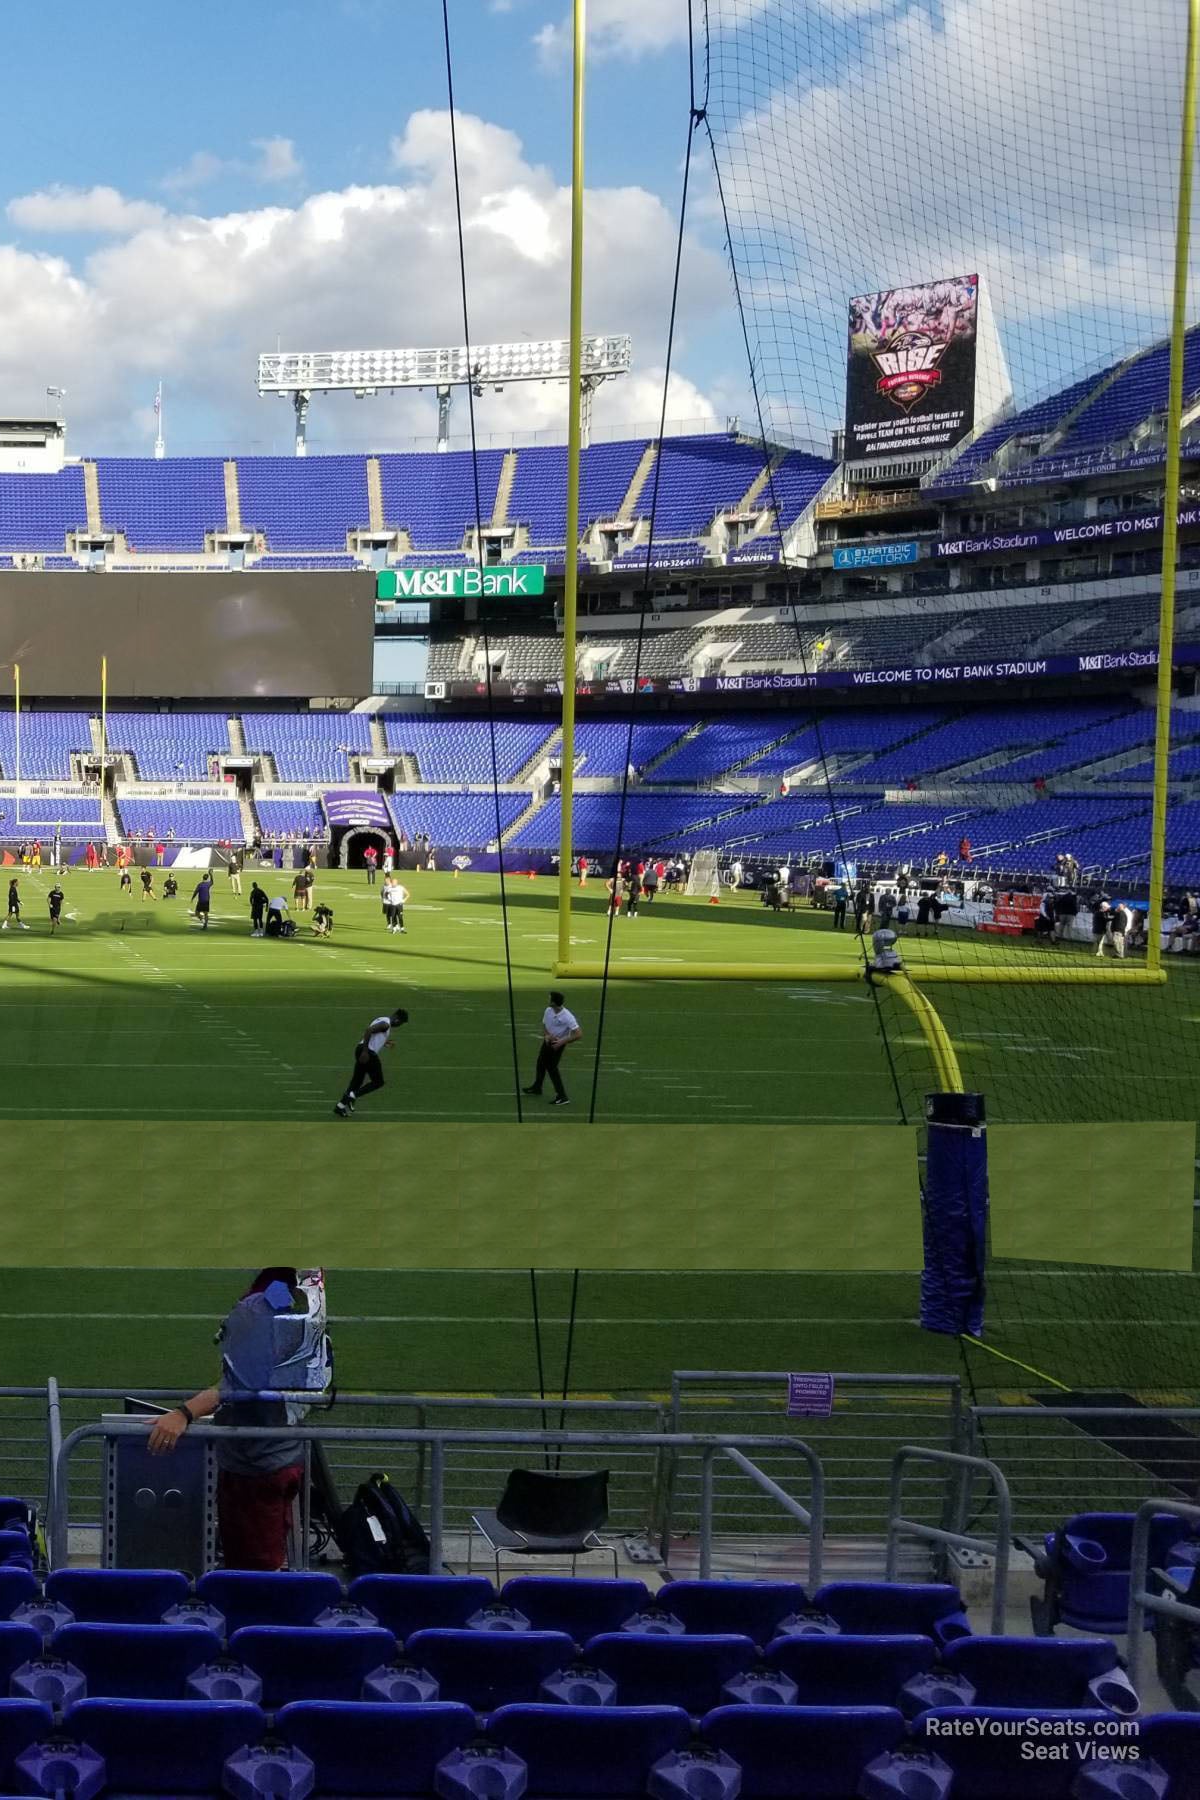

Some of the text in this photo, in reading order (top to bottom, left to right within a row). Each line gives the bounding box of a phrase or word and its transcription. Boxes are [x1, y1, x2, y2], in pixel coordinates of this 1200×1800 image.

[875, 343, 948, 376] RISE
[853, 421, 877, 433] Register
[878, 420, 892, 430] your
[893, 417, 910, 428] youth
[910, 412, 934, 424] football
[934, 411, 950, 420] team
[950, 411, 960, 419] as
[878, 428, 894, 439] TEAM
[894, 427, 904, 436] ON
[904, 425, 916, 434] THE
[916, 423, 931, 433] RISE
[931, 422, 941, 430] for
[942, 419, 960, 429] FREE!
[1053, 523, 1112, 542] WELCOME
[1115, 520, 1132, 533] TO
[1134, 516, 1161, 531] M&T
[854, 544, 911, 557] STRATEGIC
[937, 535, 1038, 556] M&T Bank Stadium
[854, 552, 910, 565] FACTORY
[394, 567, 528, 596] M&T Bank
[1079, 650, 1160, 670] M&T Bank Stadiu
[715, 675, 817, 690] M&T Bank Stadium
[853, 660, 1047, 684] WELCOME TO M&T BANK STADIUM
